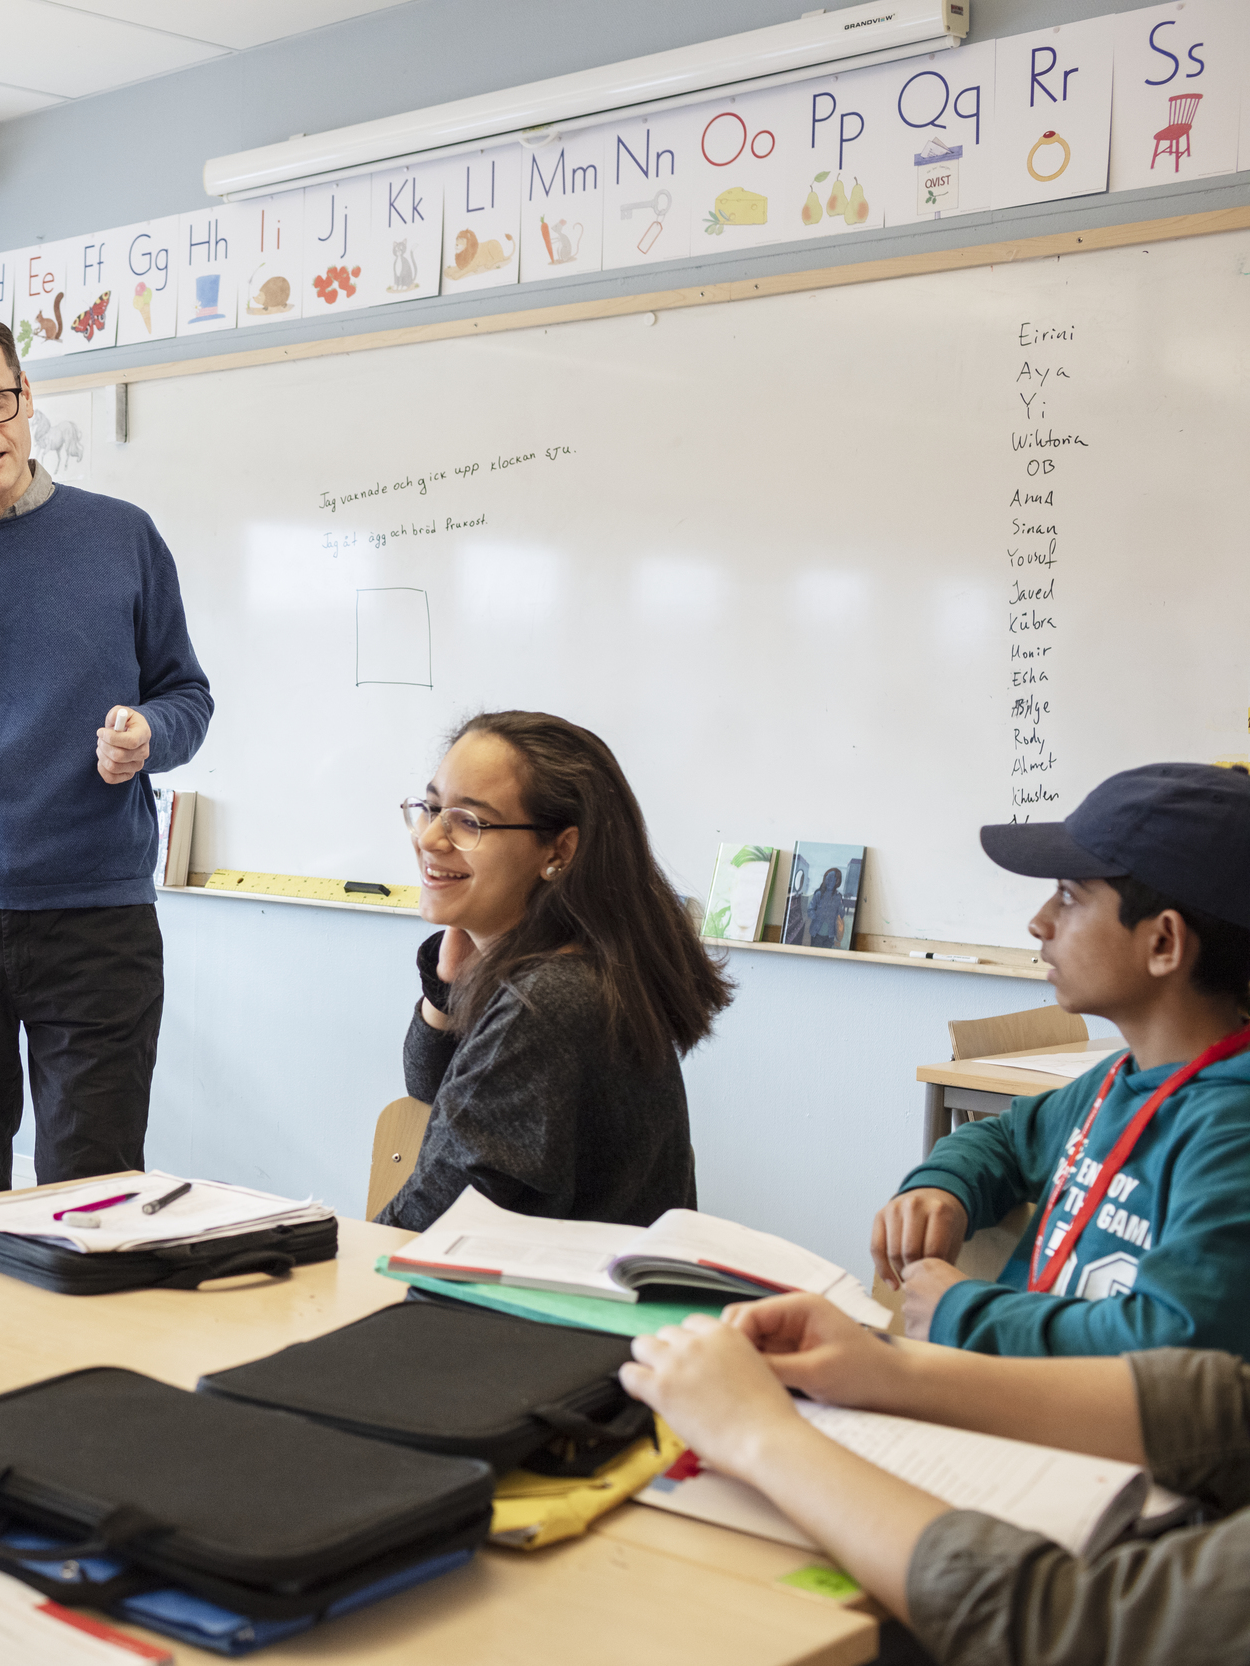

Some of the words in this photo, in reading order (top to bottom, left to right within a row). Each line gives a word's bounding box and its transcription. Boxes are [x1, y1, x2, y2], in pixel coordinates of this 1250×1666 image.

[28, 257, 55, 297] Ee
[83, 242, 105, 286] Ff
[128, 234, 168, 291] Gg
[189, 219, 228, 266] Hh
[318, 195, 348, 259] Jj
[388, 177, 424, 228] Kk
[529, 147, 597, 201] Mm
[616, 129, 674, 185] Nn
[701, 112, 775, 166] Oo
[812, 92, 864, 170] Pp
[897, 70, 981, 145] Qq
[1030, 46, 1079, 108] Rr
[1144, 20, 1205, 86] Ss
[924, 174, 951, 189] QVIST
[1016, 361, 1070, 387] Aya
[1020, 392, 1046, 419] Yi
[1027, 459, 1055, 476] OB
[318, 491, 336, 512] Jag
[340, 482, 387, 505] vaknade
[393, 476, 413, 492] och
[417, 470, 447, 495] gick
[454, 462, 480, 478] upp
[490, 452, 536, 472] klockan
[322, 532, 338, 558] Jag
[390, 524, 407, 538] och
[412, 519, 437, 536] bröd
[1009, 578, 1055, 605] Javed
[1012, 667, 1049, 687] Esha
[1075, 1157, 1140, 1203] ENOY
